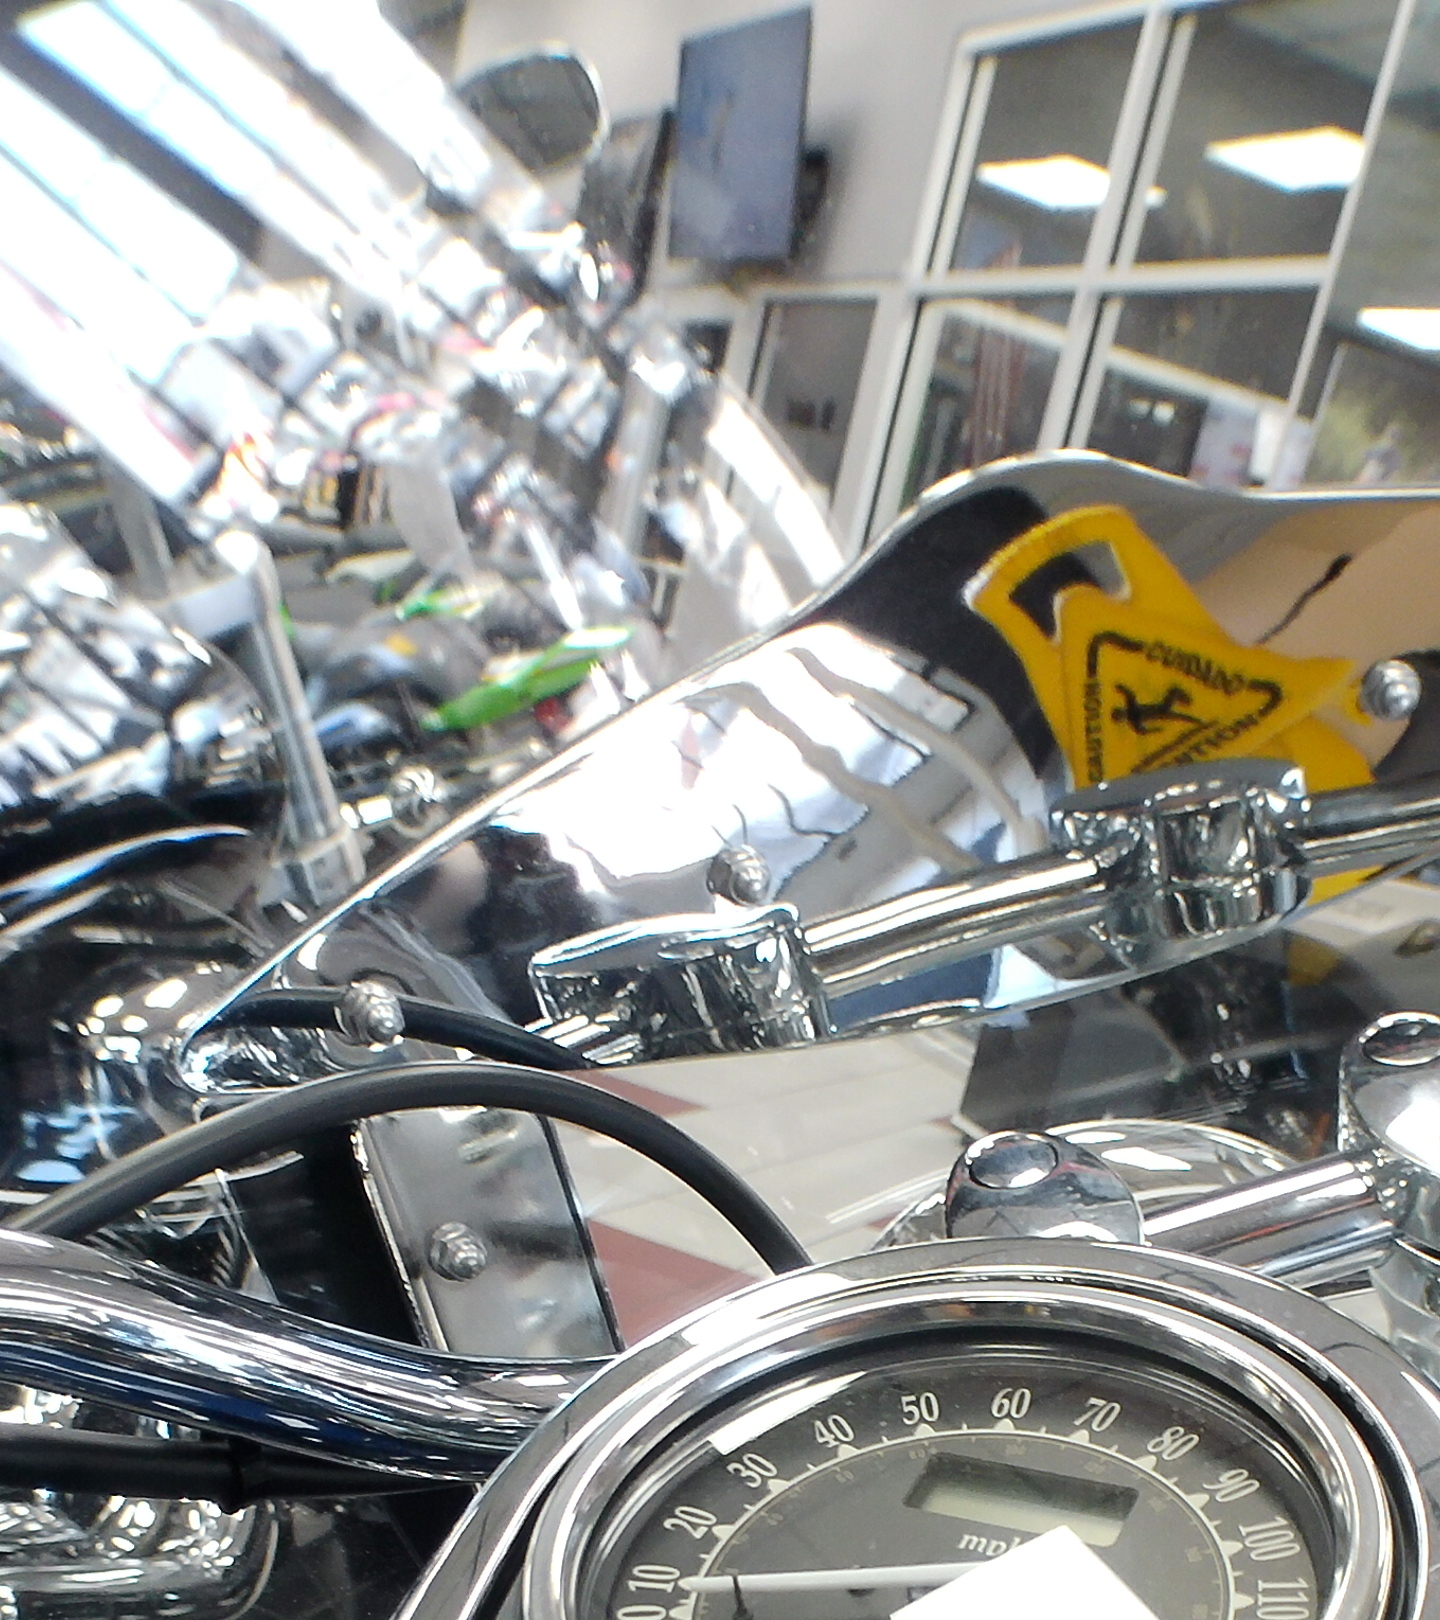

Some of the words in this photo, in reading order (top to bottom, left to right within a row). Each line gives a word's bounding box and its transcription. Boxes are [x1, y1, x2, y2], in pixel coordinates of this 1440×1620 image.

[1084, 682, 1103, 783] CAUTION
[900, 1392, 939, 1426] 50
[991, 1388, 1031, 1418] 60
[1073, 1397, 1121, 1432] 70
[814, 1414, 855, 1447] 40
[1146, 1426, 1200, 1461] 80
[727, 1453, 778, 1488] 30
[1203, 1469, 1260, 1503] 90
[663, 1506, 717, 1539] 20
[1238, 1516, 1301, 1561] 100
[959, 1533, 1021, 1558] mp
[628, 1564, 680, 1593] 10
[1256, 1577, 1310, 1620] 110
